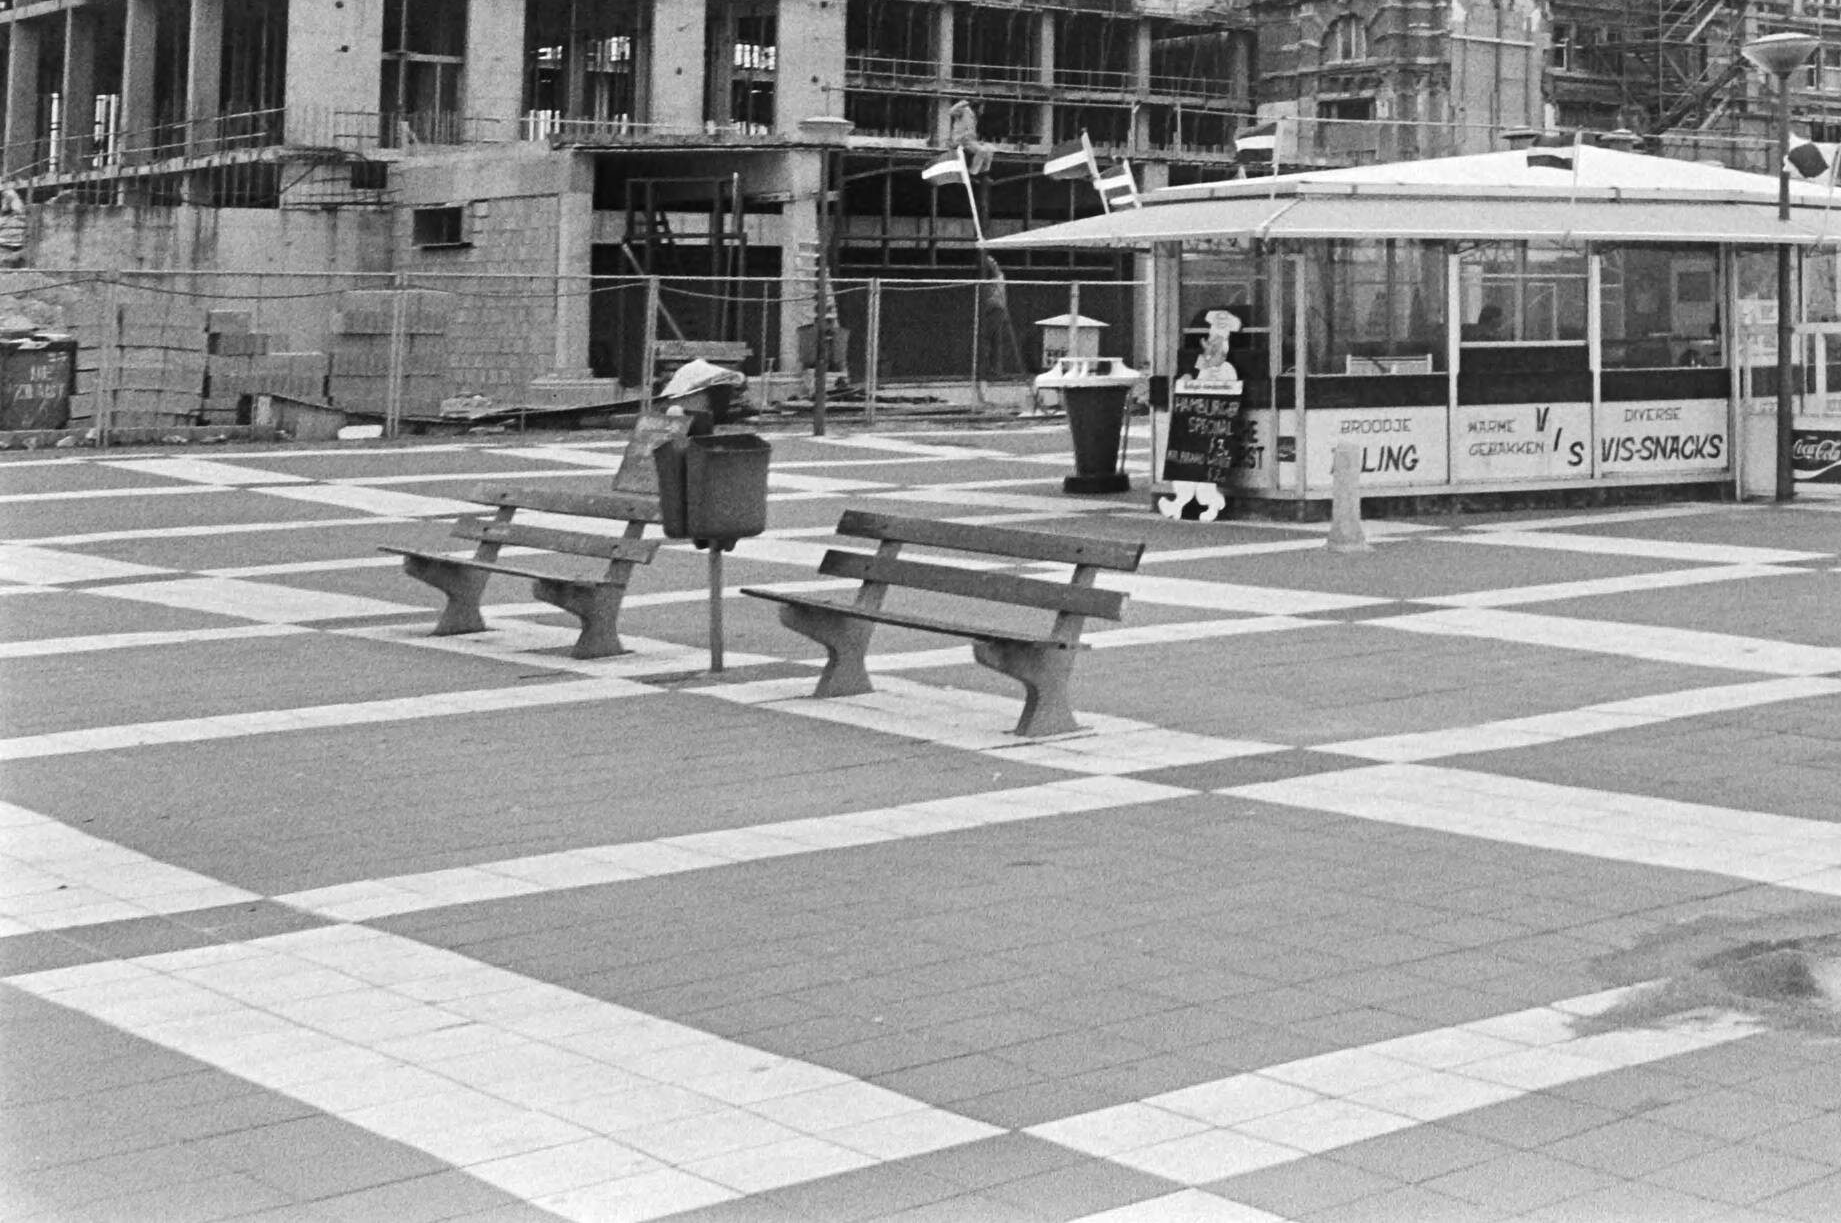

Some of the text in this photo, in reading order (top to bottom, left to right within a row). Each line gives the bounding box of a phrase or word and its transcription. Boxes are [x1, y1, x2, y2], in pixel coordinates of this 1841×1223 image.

[1624, 406, 1682, 422] DIVERSE
[1340, 418, 1412, 434] BROODJE
[1468, 441, 1544, 456] GEBAKKEN
[1601, 434, 1723, 463] VIS-SNACKS
